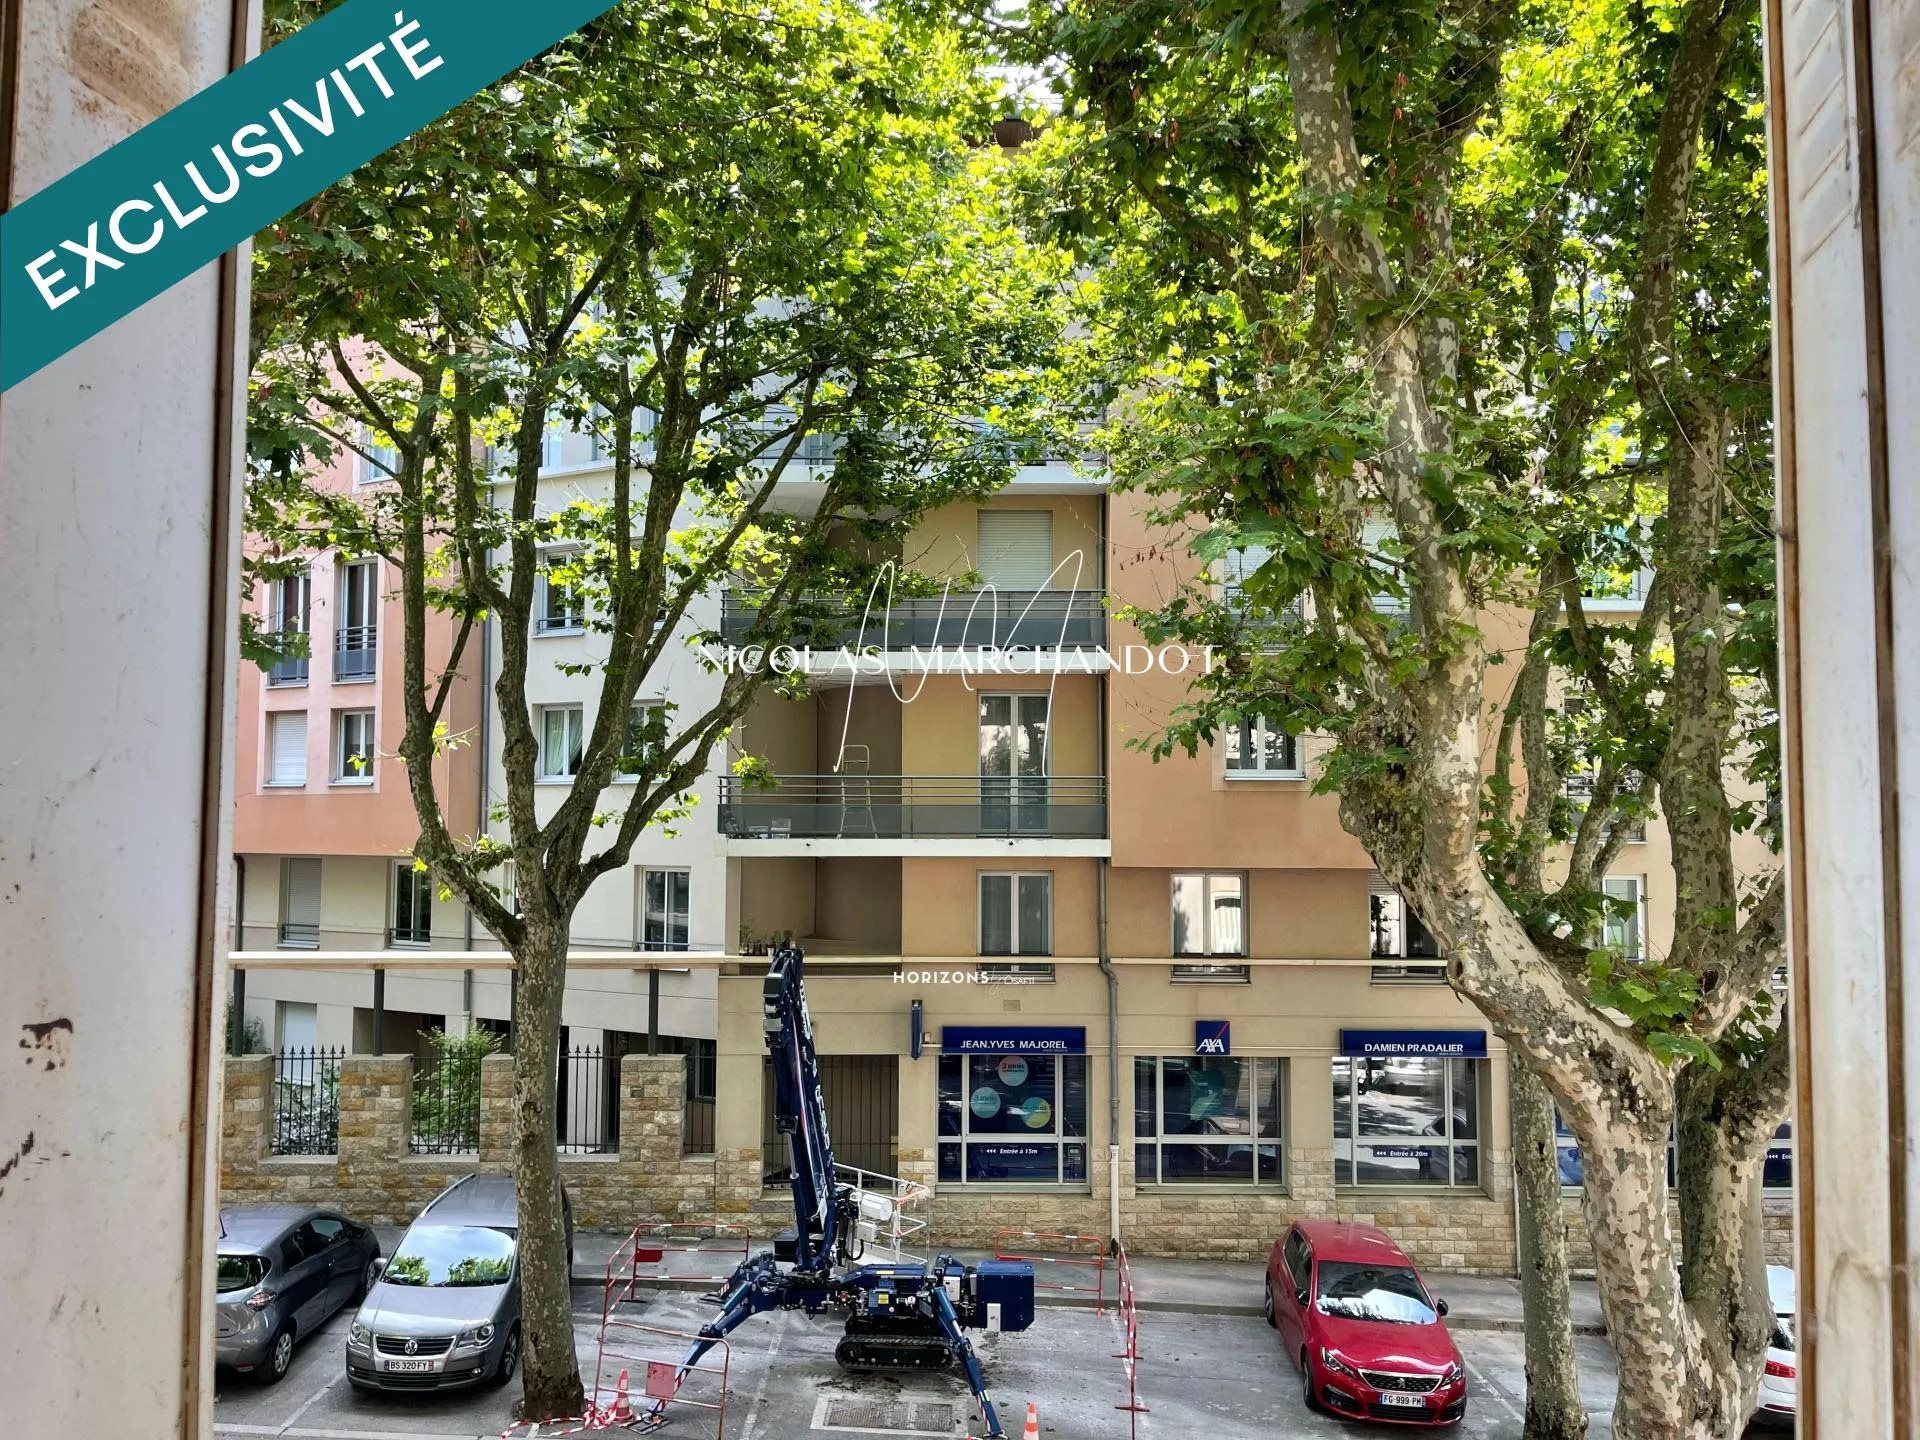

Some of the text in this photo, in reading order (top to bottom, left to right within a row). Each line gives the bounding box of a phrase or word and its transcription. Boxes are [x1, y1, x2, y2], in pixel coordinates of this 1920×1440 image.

[1019, 1040, 1067, 1049] MAJOREL
[1196, 1038, 1224, 1053] AXA
[1364, 1043, 1463, 1053] DAMIEN PRADALIER
